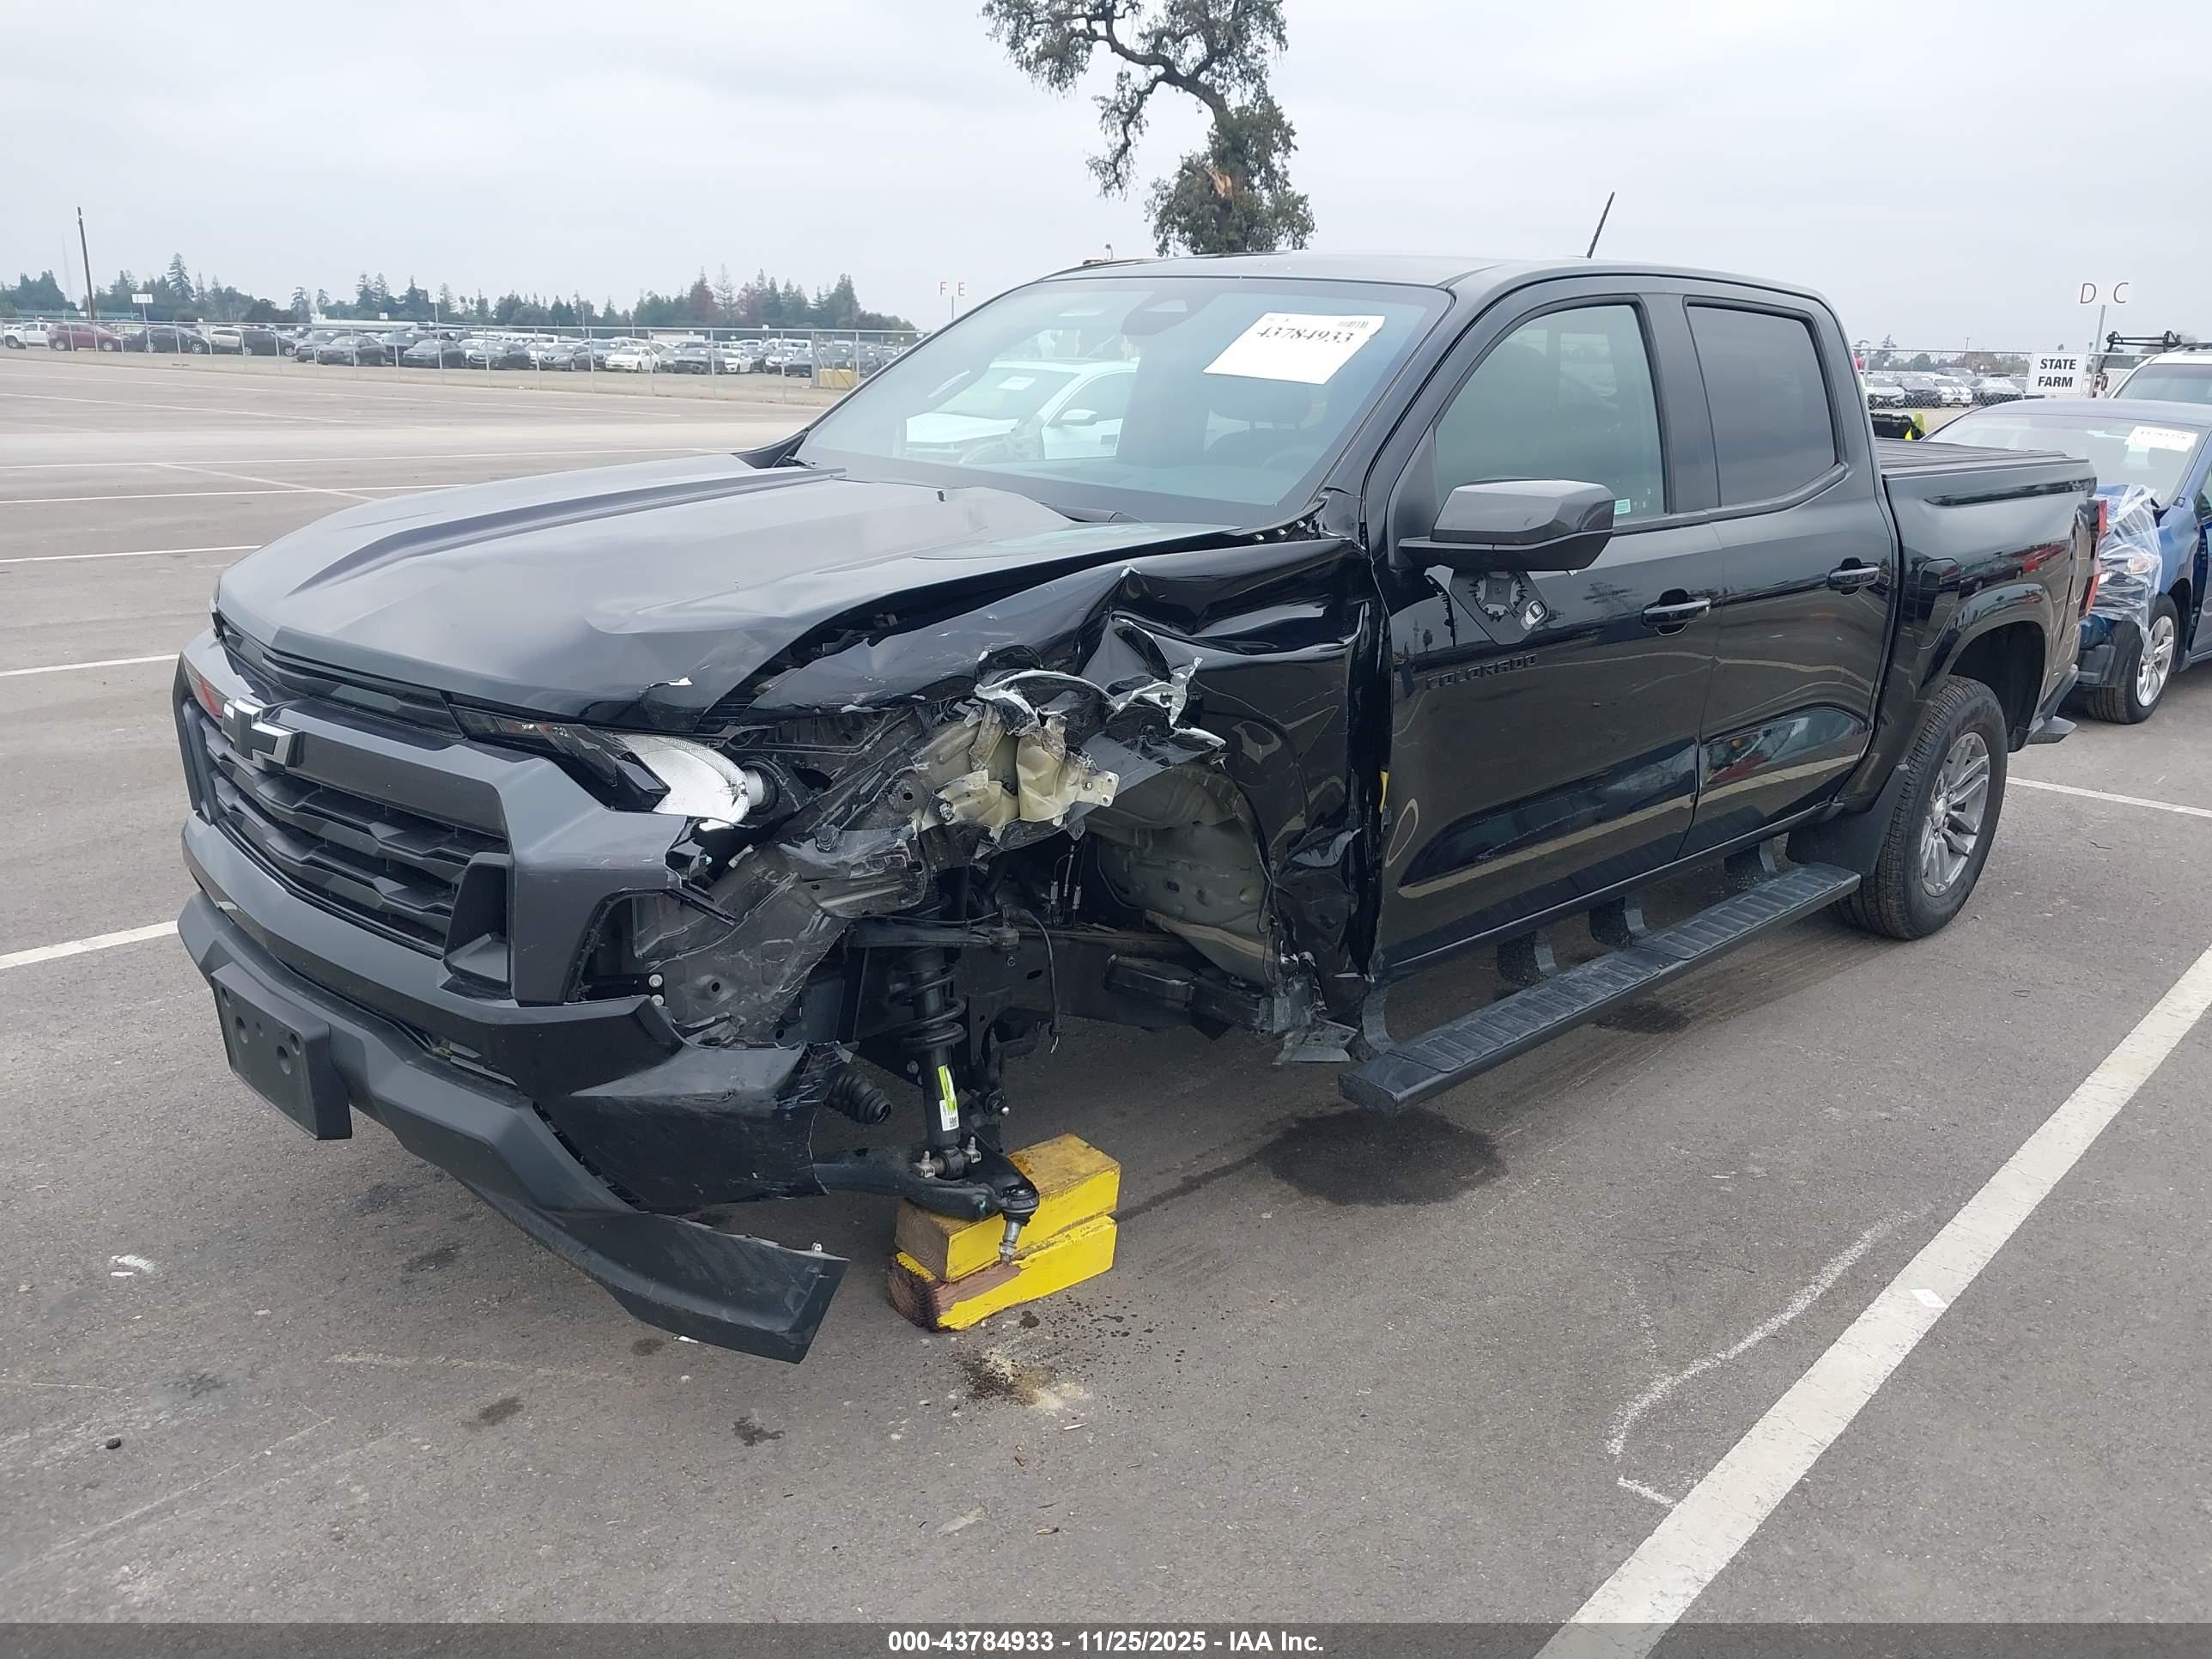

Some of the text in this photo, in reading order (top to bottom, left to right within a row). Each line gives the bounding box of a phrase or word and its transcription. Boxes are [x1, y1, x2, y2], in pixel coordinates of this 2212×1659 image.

[939, 282, 965, 296] F E
[2080, 282, 2129, 304] D C
[1256, 326, 1354, 343] 43784933
[2039, 358, 2077, 370] STATE
[2037, 376, 2074, 388] FARM
